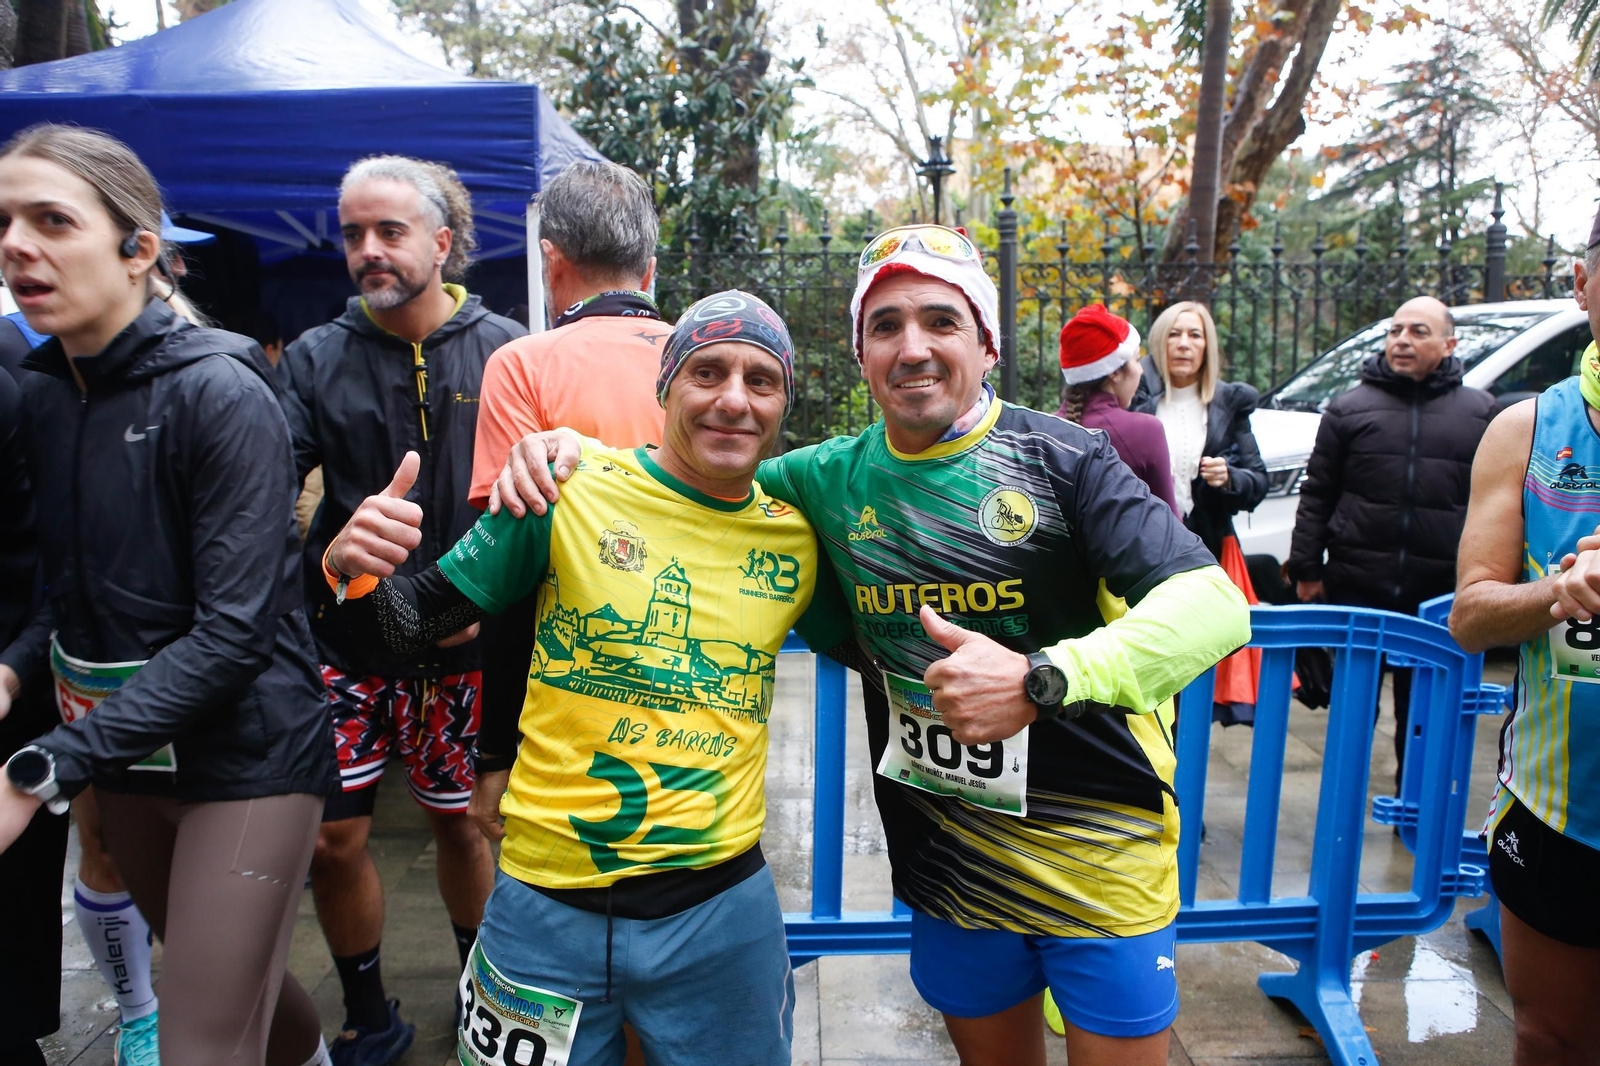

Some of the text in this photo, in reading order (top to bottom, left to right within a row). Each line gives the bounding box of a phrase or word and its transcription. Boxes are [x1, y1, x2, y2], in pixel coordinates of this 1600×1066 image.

[738, 587, 768, 600] RUNNERS
[854, 578, 1025, 615] RUTEROS
[606, 716, 738, 758] LOS BARRIOS
[899, 713, 1004, 780] 309
[945, 773, 968, 785] MANUEL
[968, 777, 987, 790] JESÚS
[463, 978, 548, 1066] 330
[496, 990, 544, 1021] NAVIDAD
[502, 1010, 540, 1029] ALGECIRAS
